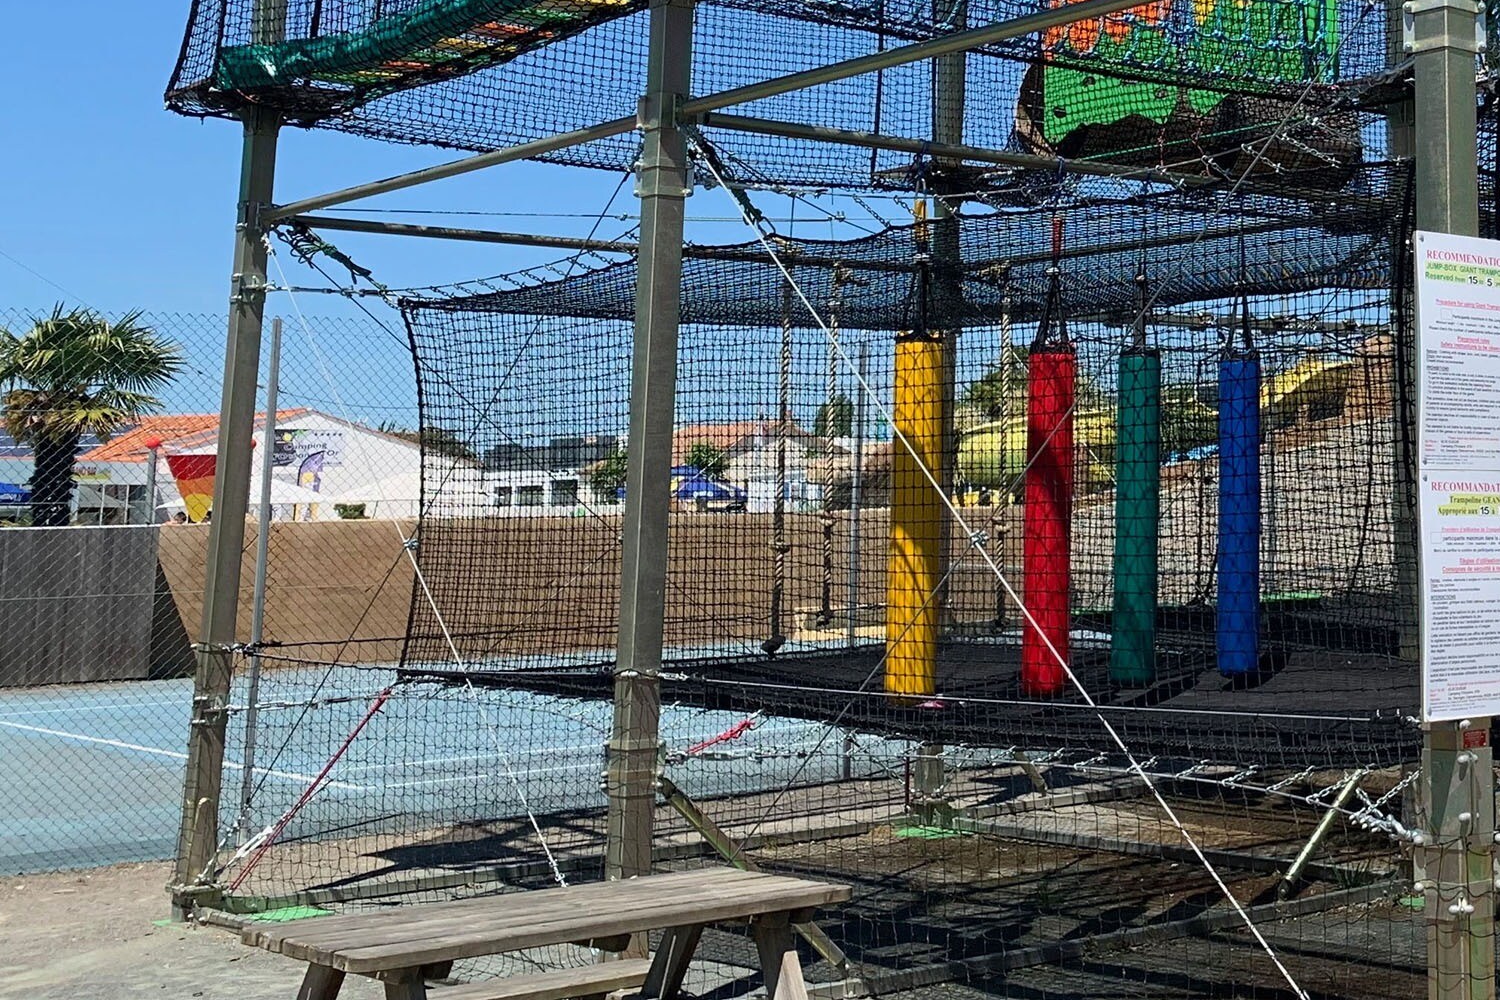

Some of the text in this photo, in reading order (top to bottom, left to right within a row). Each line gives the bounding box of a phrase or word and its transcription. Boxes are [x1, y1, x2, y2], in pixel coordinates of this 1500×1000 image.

[1425, 272, 1454, 281] Reserved
[1469, 276, 1478, 285] 15
[1487, 279, 1493, 287] 5
[1480, 507, 1490, 515] 15
